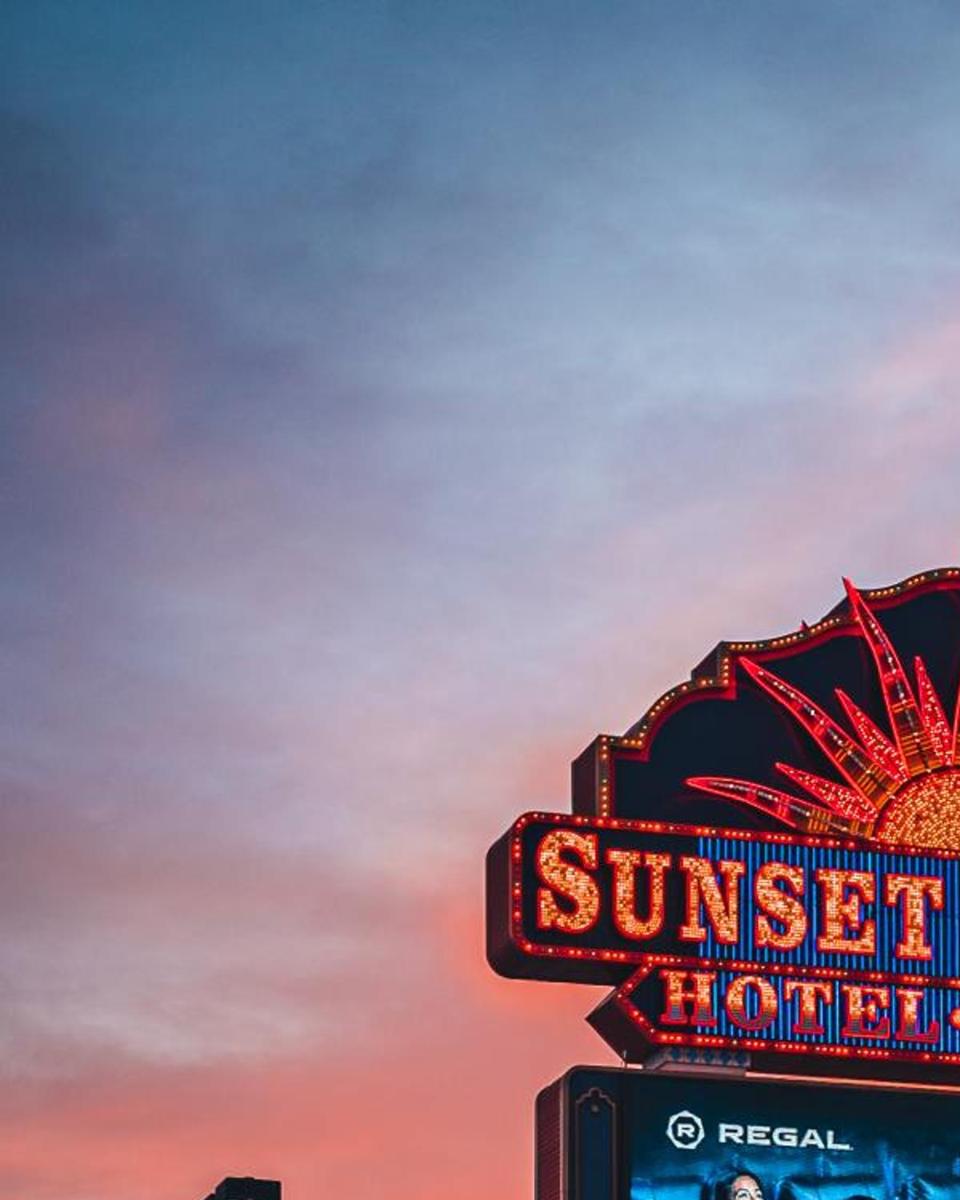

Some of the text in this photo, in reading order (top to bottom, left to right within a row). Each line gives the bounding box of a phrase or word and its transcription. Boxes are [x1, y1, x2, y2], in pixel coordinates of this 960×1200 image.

[536, 828, 943, 960] SUNSET
[660, 970, 940, 1044] HOTEL
[718, 1123, 853, 1150] REGAL
